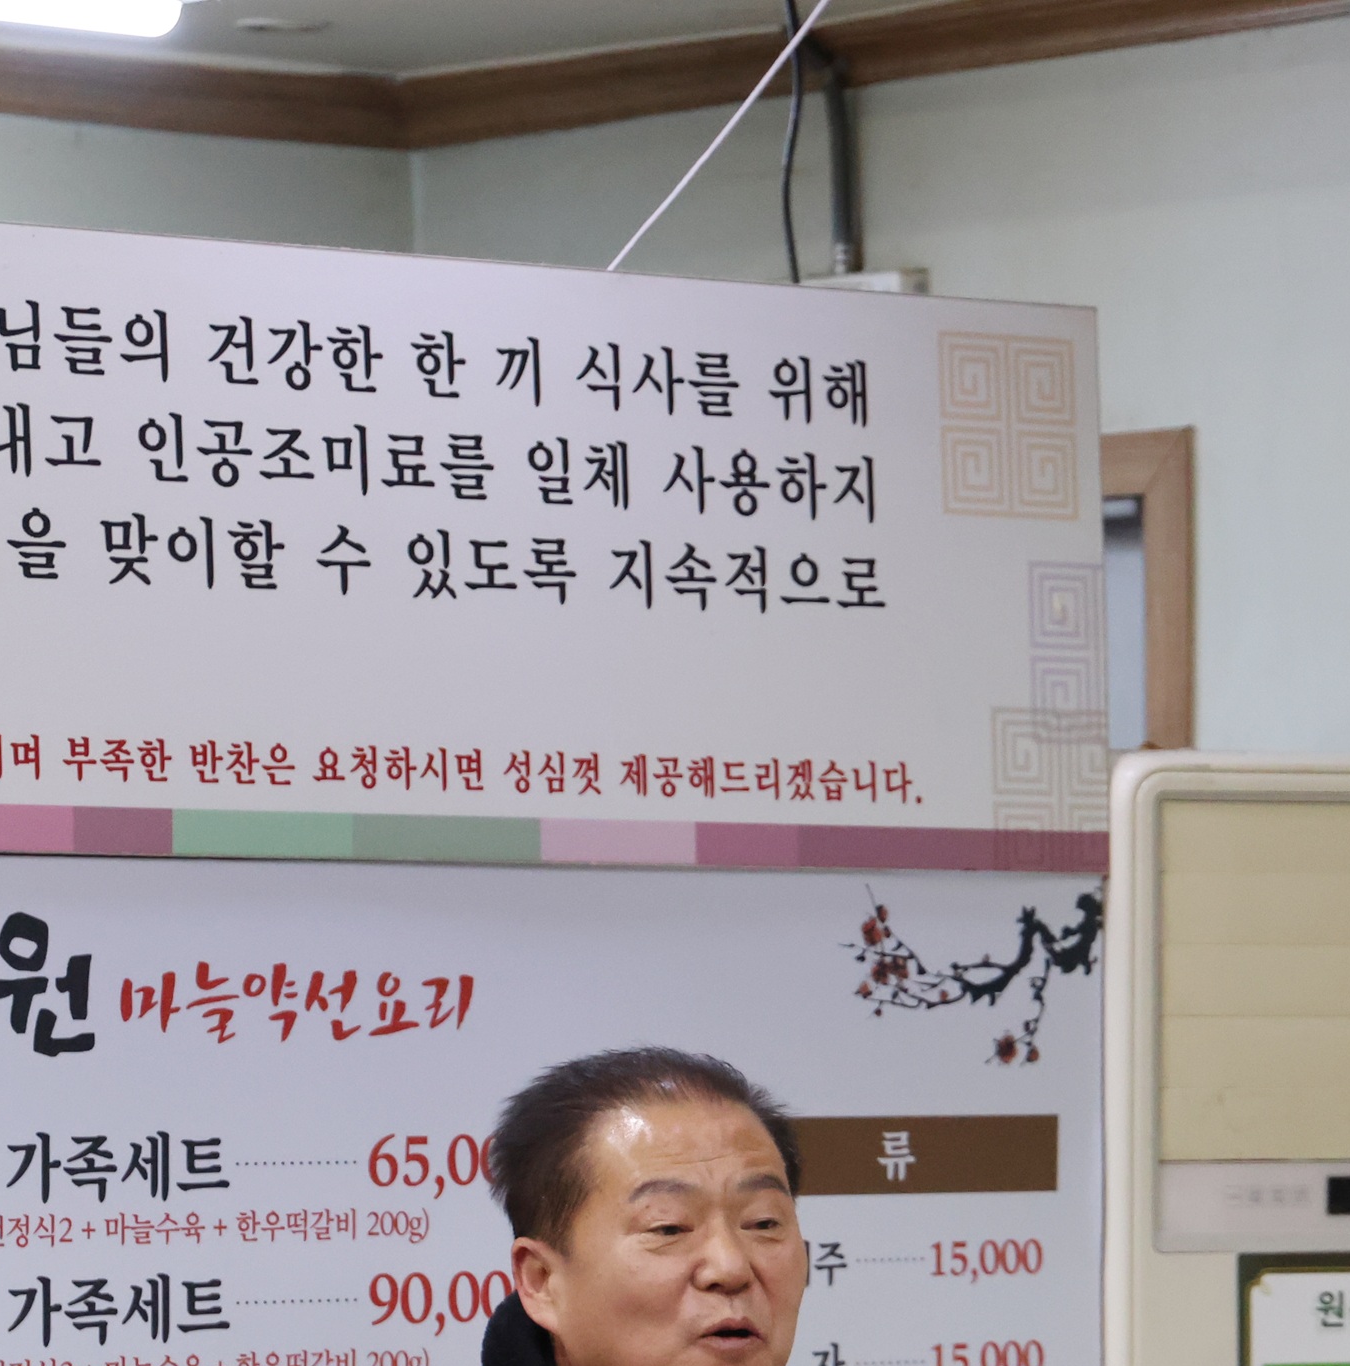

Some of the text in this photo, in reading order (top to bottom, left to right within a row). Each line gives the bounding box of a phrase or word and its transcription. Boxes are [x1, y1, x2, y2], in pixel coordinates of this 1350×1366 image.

[208, 316, 383, 393] 건강한
[411, 330, 466, 398] 한
[496, 337, 541, 407] 끼
[576, 342, 740, 417] 식사를
[769, 356, 867, 428] 위해
[138, 412, 494, 500] 인공조미료를
[528, 437, 629, 510] 일체
[663, 445, 875, 523] 사용하지
[100, 512, 285, 590] 맞이할
[316, 525, 371, 595] 수
[407, 529, 577, 605] 있도록
[610, 540, 886, 614] 지속적으로
[63, 736, 172, 782] 부족한
[189, 740, 295, 785] 반찬은
[313, 745, 484, 791] 요청하시면
[504, 750, 601, 795] 성심껏
[620, 754, 922, 803] 제공해드리겠습니다.
[120, 961, 474, 1044] 마늘약선요리
[6, 1131, 230, 1204] 가족세트
[877, 1131, 915, 1181] 류
[105, 1212, 205, 1245] 마늘수육
[236, 1208, 356, 1242] 한우떡갈비
[368, 1209, 429, 1243] 200g)
[803, 1238, 1043, 1287] 주 15,000
[8, 1273, 230, 1348] 가족세트
